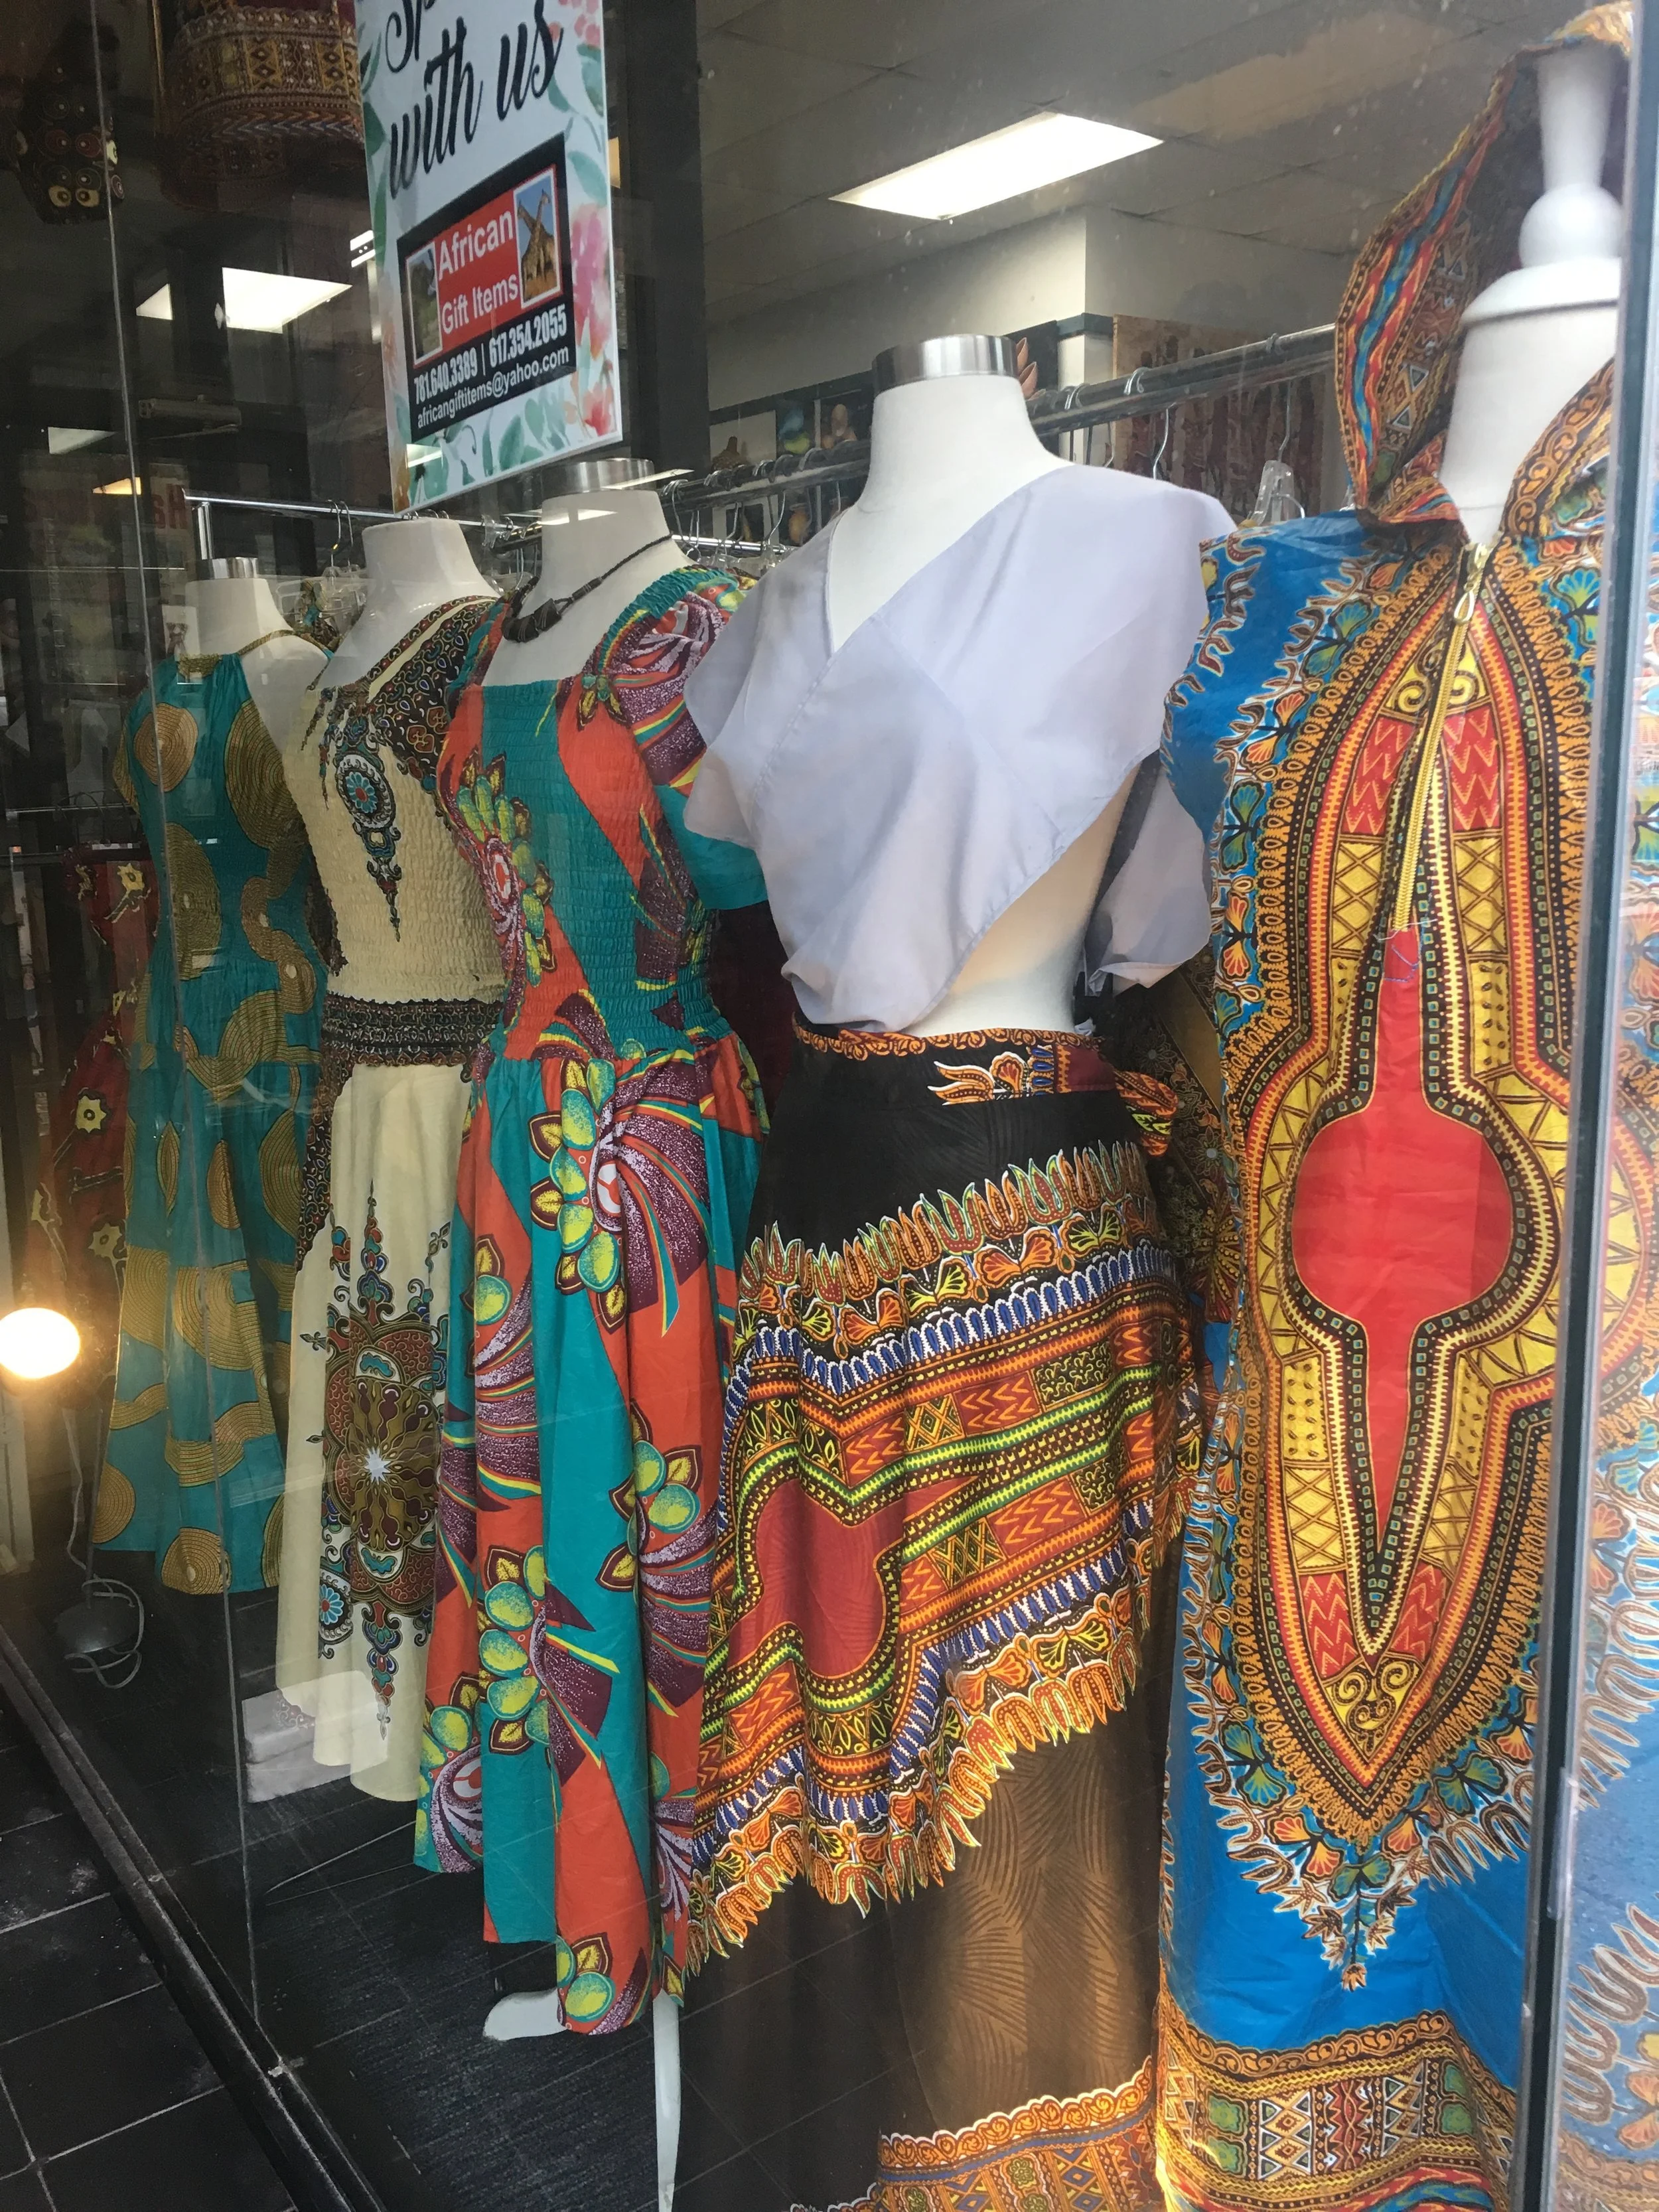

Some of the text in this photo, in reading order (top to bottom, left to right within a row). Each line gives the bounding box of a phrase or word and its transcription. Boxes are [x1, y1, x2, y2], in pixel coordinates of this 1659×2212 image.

[389, 16, 483, 199] with
[496, 0, 564, 121] us
[438, 209, 514, 281] African
[442, 273, 519, 334] Gift Items
[414, 347, 478, 405] 781.640.3389
[489, 303, 567, 368] 617.354.2055
[417, 346, 569, 429] africangiftitems@yahoo.com
